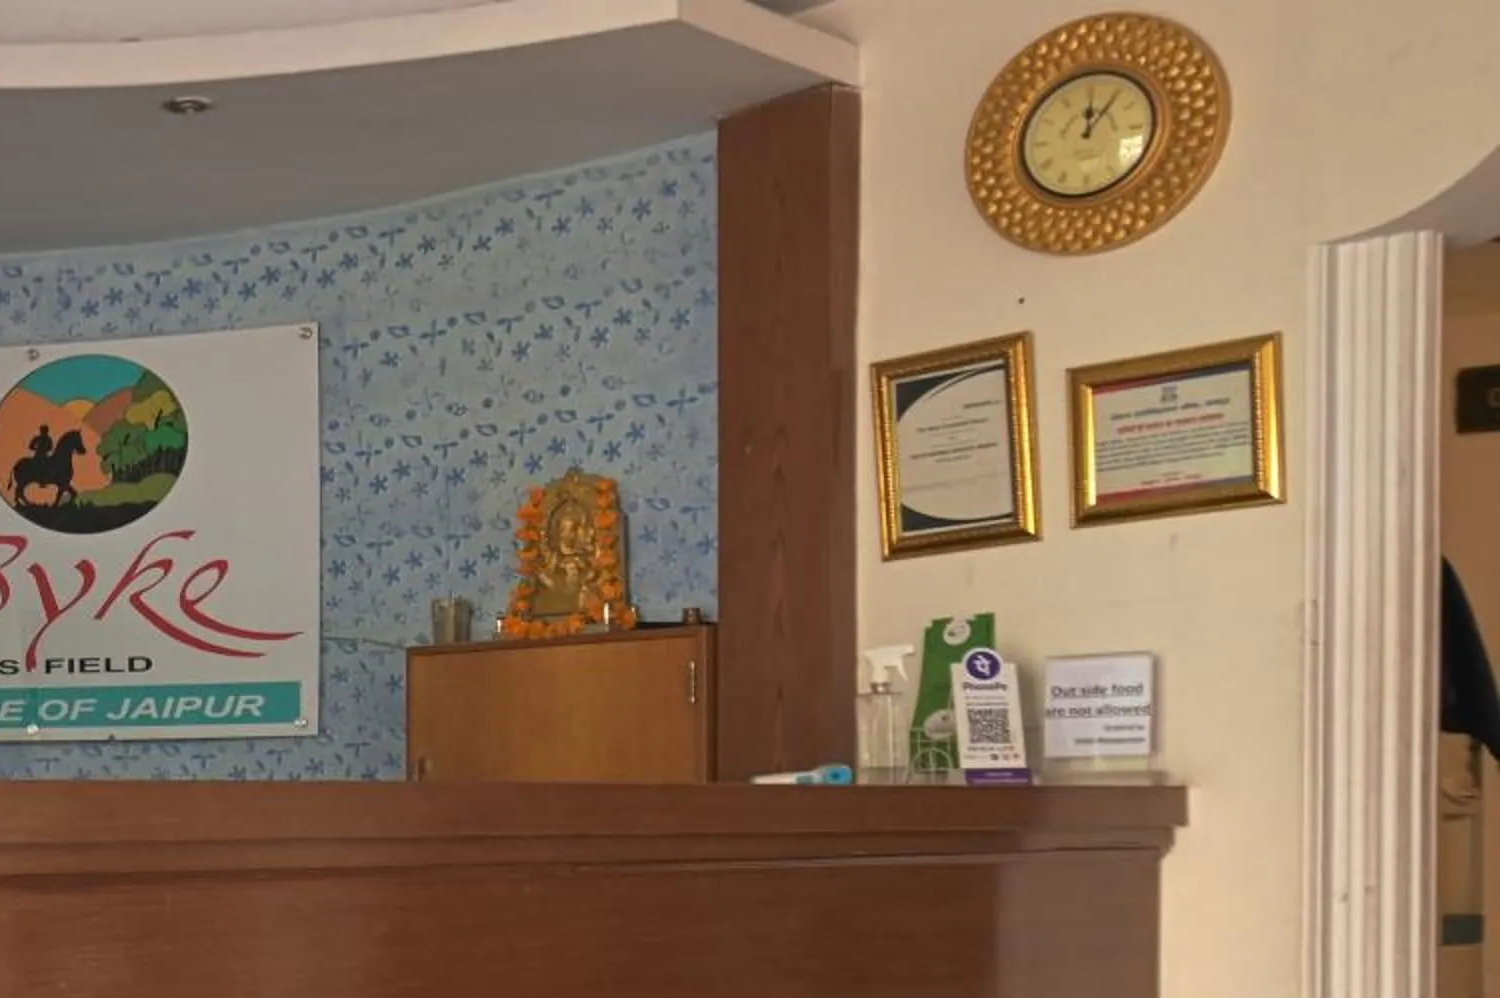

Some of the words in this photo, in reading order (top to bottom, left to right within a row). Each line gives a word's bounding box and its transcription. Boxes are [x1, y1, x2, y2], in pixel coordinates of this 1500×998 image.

[44, 656, 153, 674] FIELD
[37, 698, 97, 721] OF
[106, 695, 265, 720] JAIPUR
